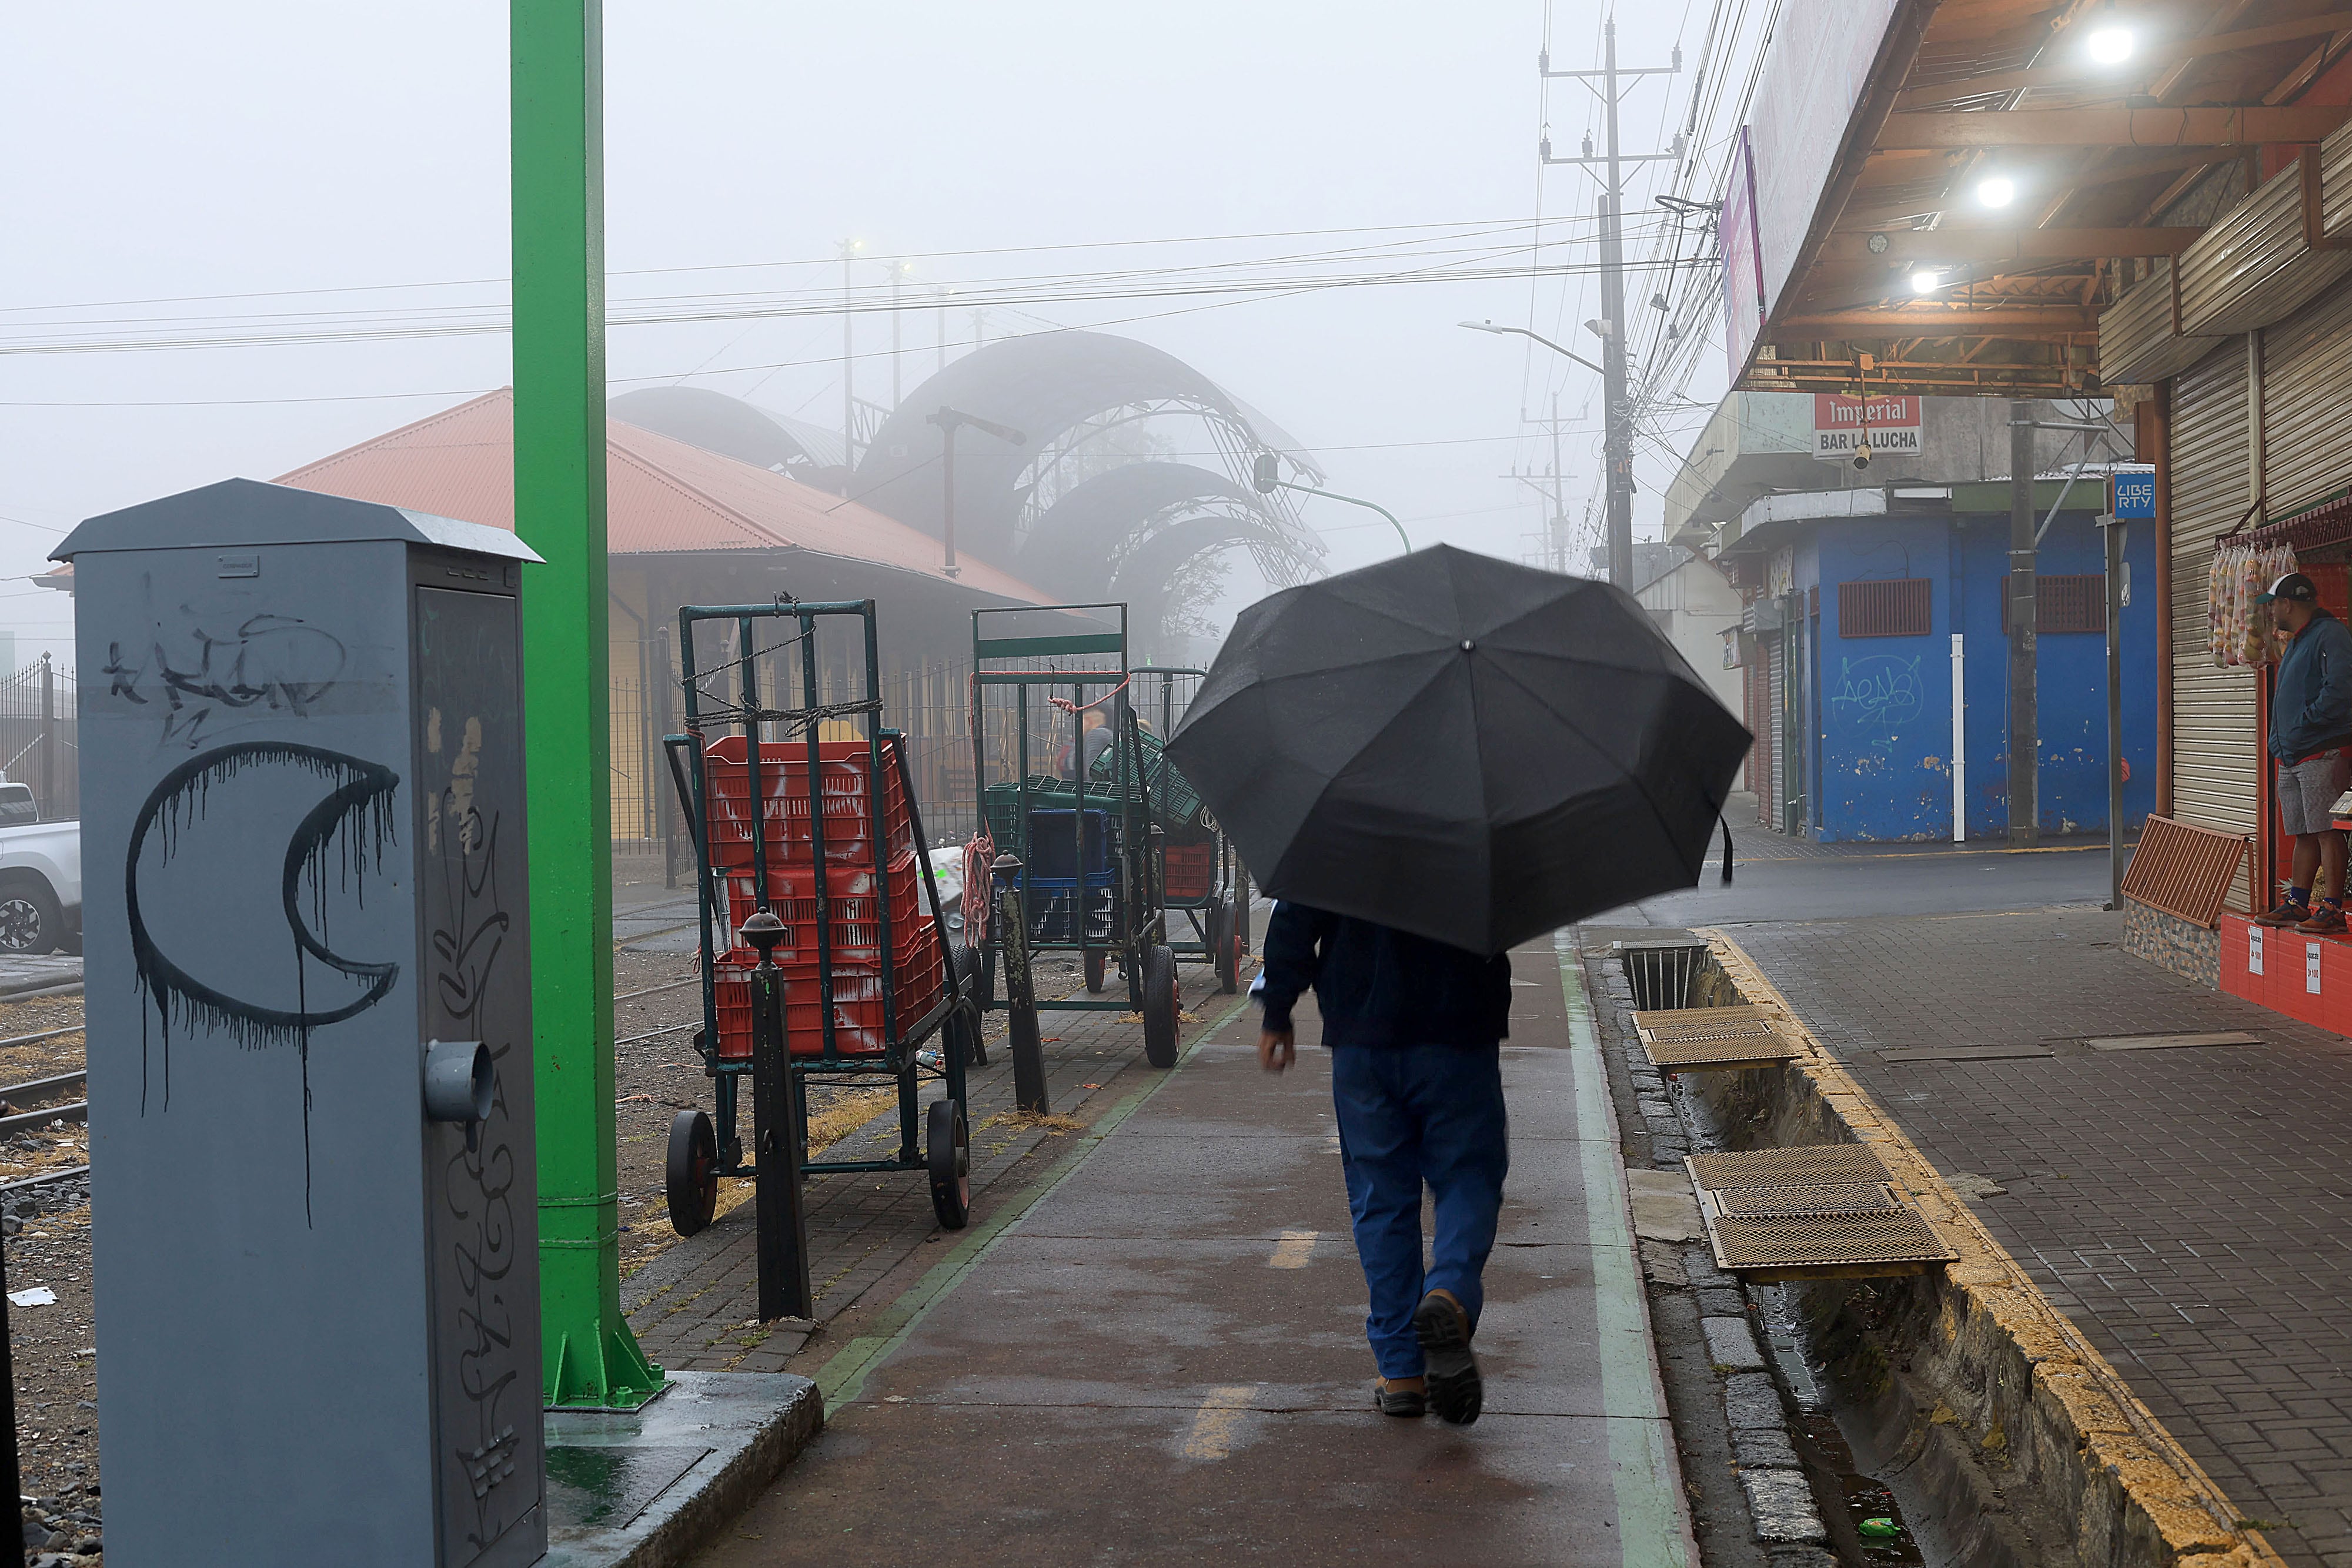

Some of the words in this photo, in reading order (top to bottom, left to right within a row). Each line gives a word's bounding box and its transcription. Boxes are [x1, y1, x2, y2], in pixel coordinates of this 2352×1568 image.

[1829, 398, 1907, 426] Imperial
[1820, 434, 1847, 450] BAR
[1873, 432, 1917, 448] LUCHA
[2117, 484, 2152, 496] LIBE
[2119, 497, 2151, 508] RTY
